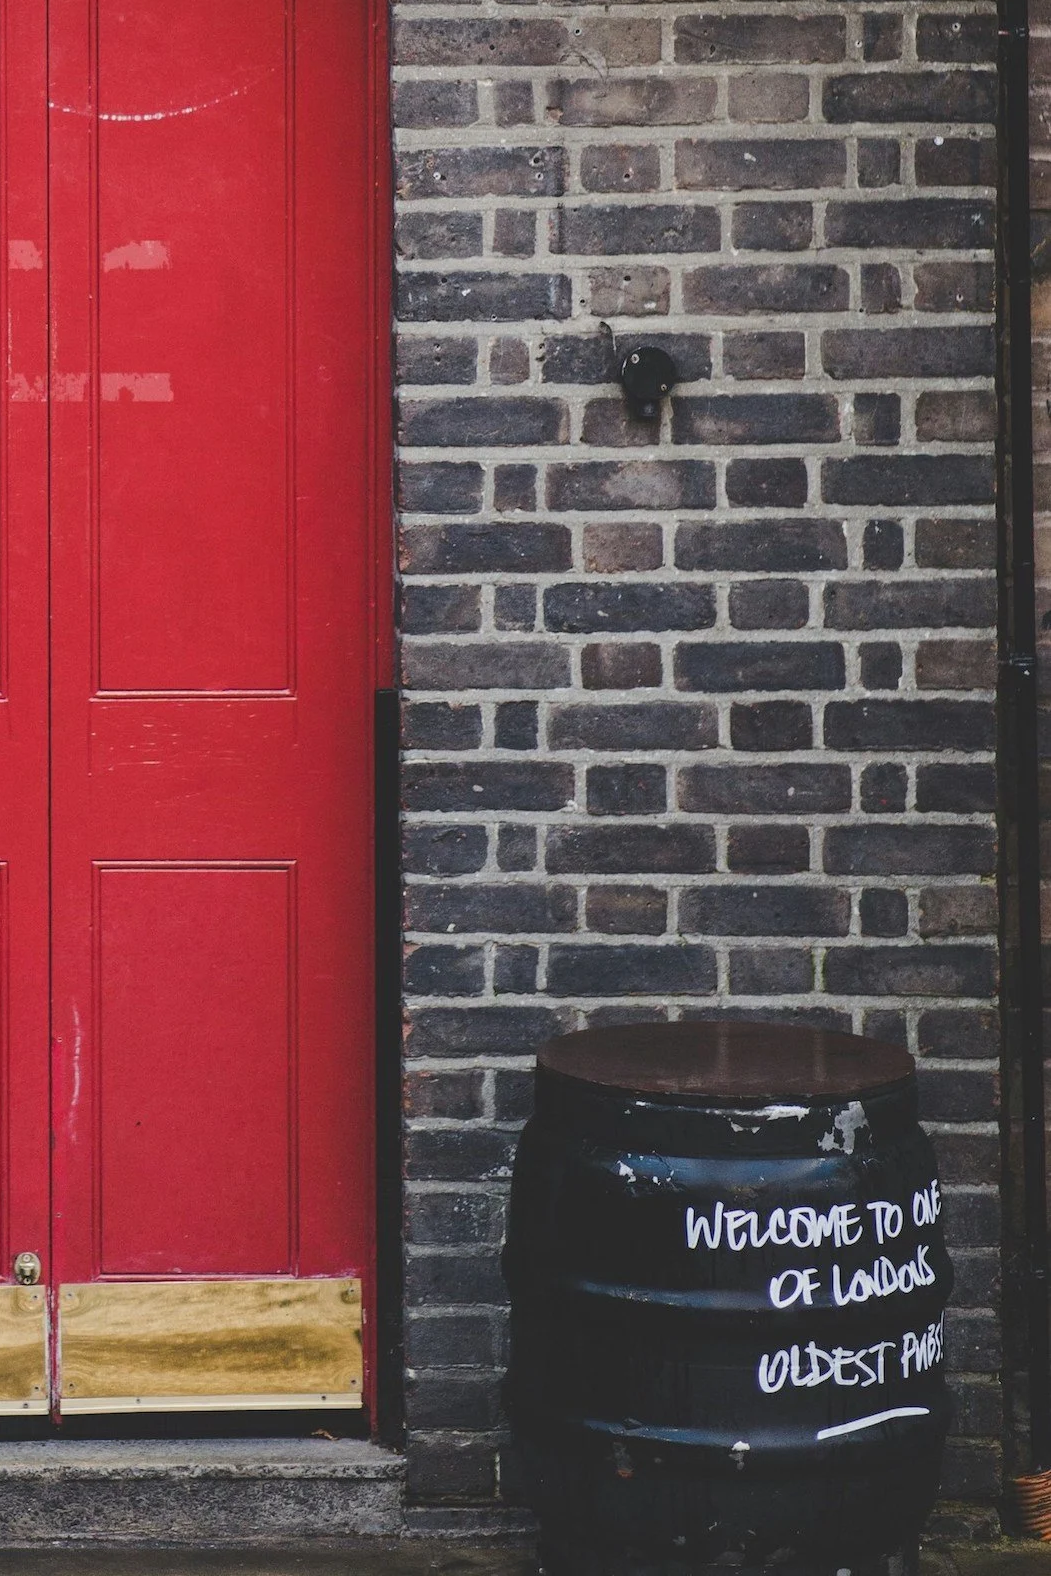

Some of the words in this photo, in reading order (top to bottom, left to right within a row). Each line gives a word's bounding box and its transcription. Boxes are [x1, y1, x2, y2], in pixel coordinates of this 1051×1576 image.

[685, 1201, 863, 1251] WELCOME
[866, 1200, 904, 1245] TO
[912, 1178, 942, 1227] ONE
[769, 1268, 821, 1309] OF
[758, 1341, 896, 1393] OLDEST
